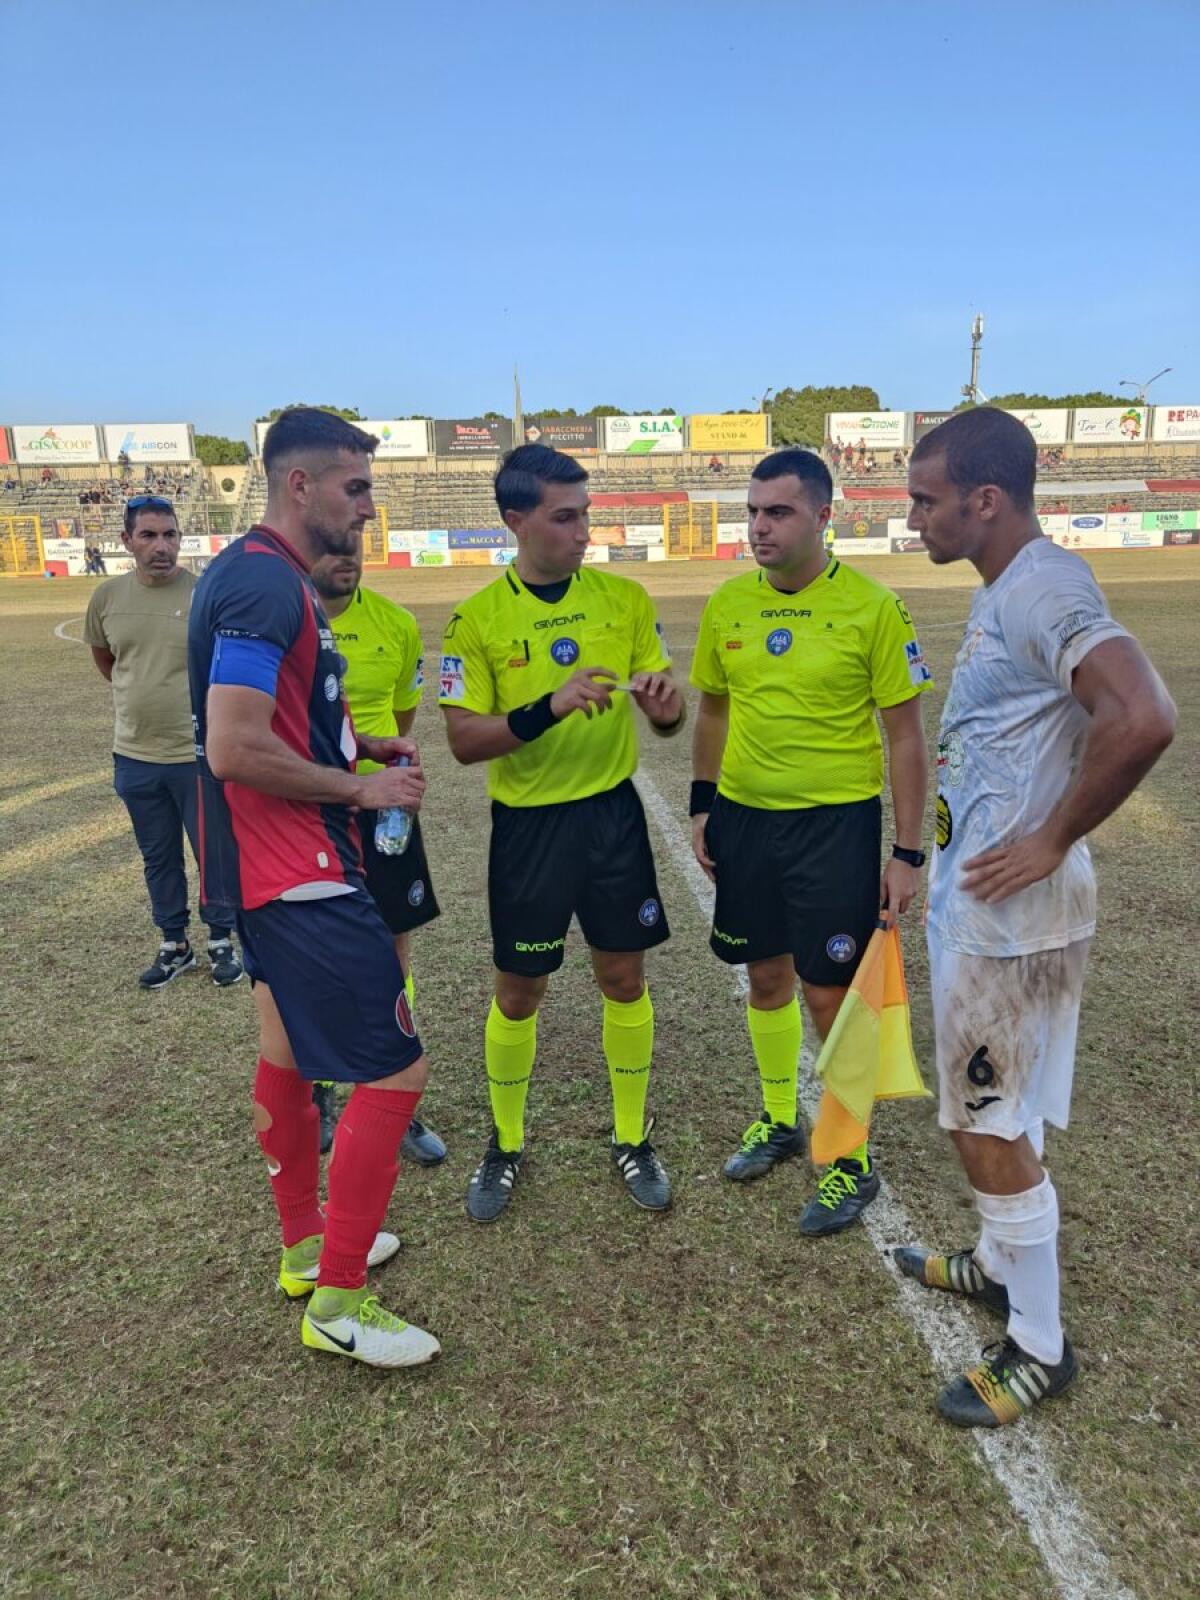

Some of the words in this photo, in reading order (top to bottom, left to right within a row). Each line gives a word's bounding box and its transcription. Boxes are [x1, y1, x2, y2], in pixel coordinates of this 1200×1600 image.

[542, 425, 593, 433] TABACCHERIA
[761, 609, 812, 618] GIVOVA
[534, 613, 586, 631] GIVOVA
[967, 1045, 994, 1087] 6
